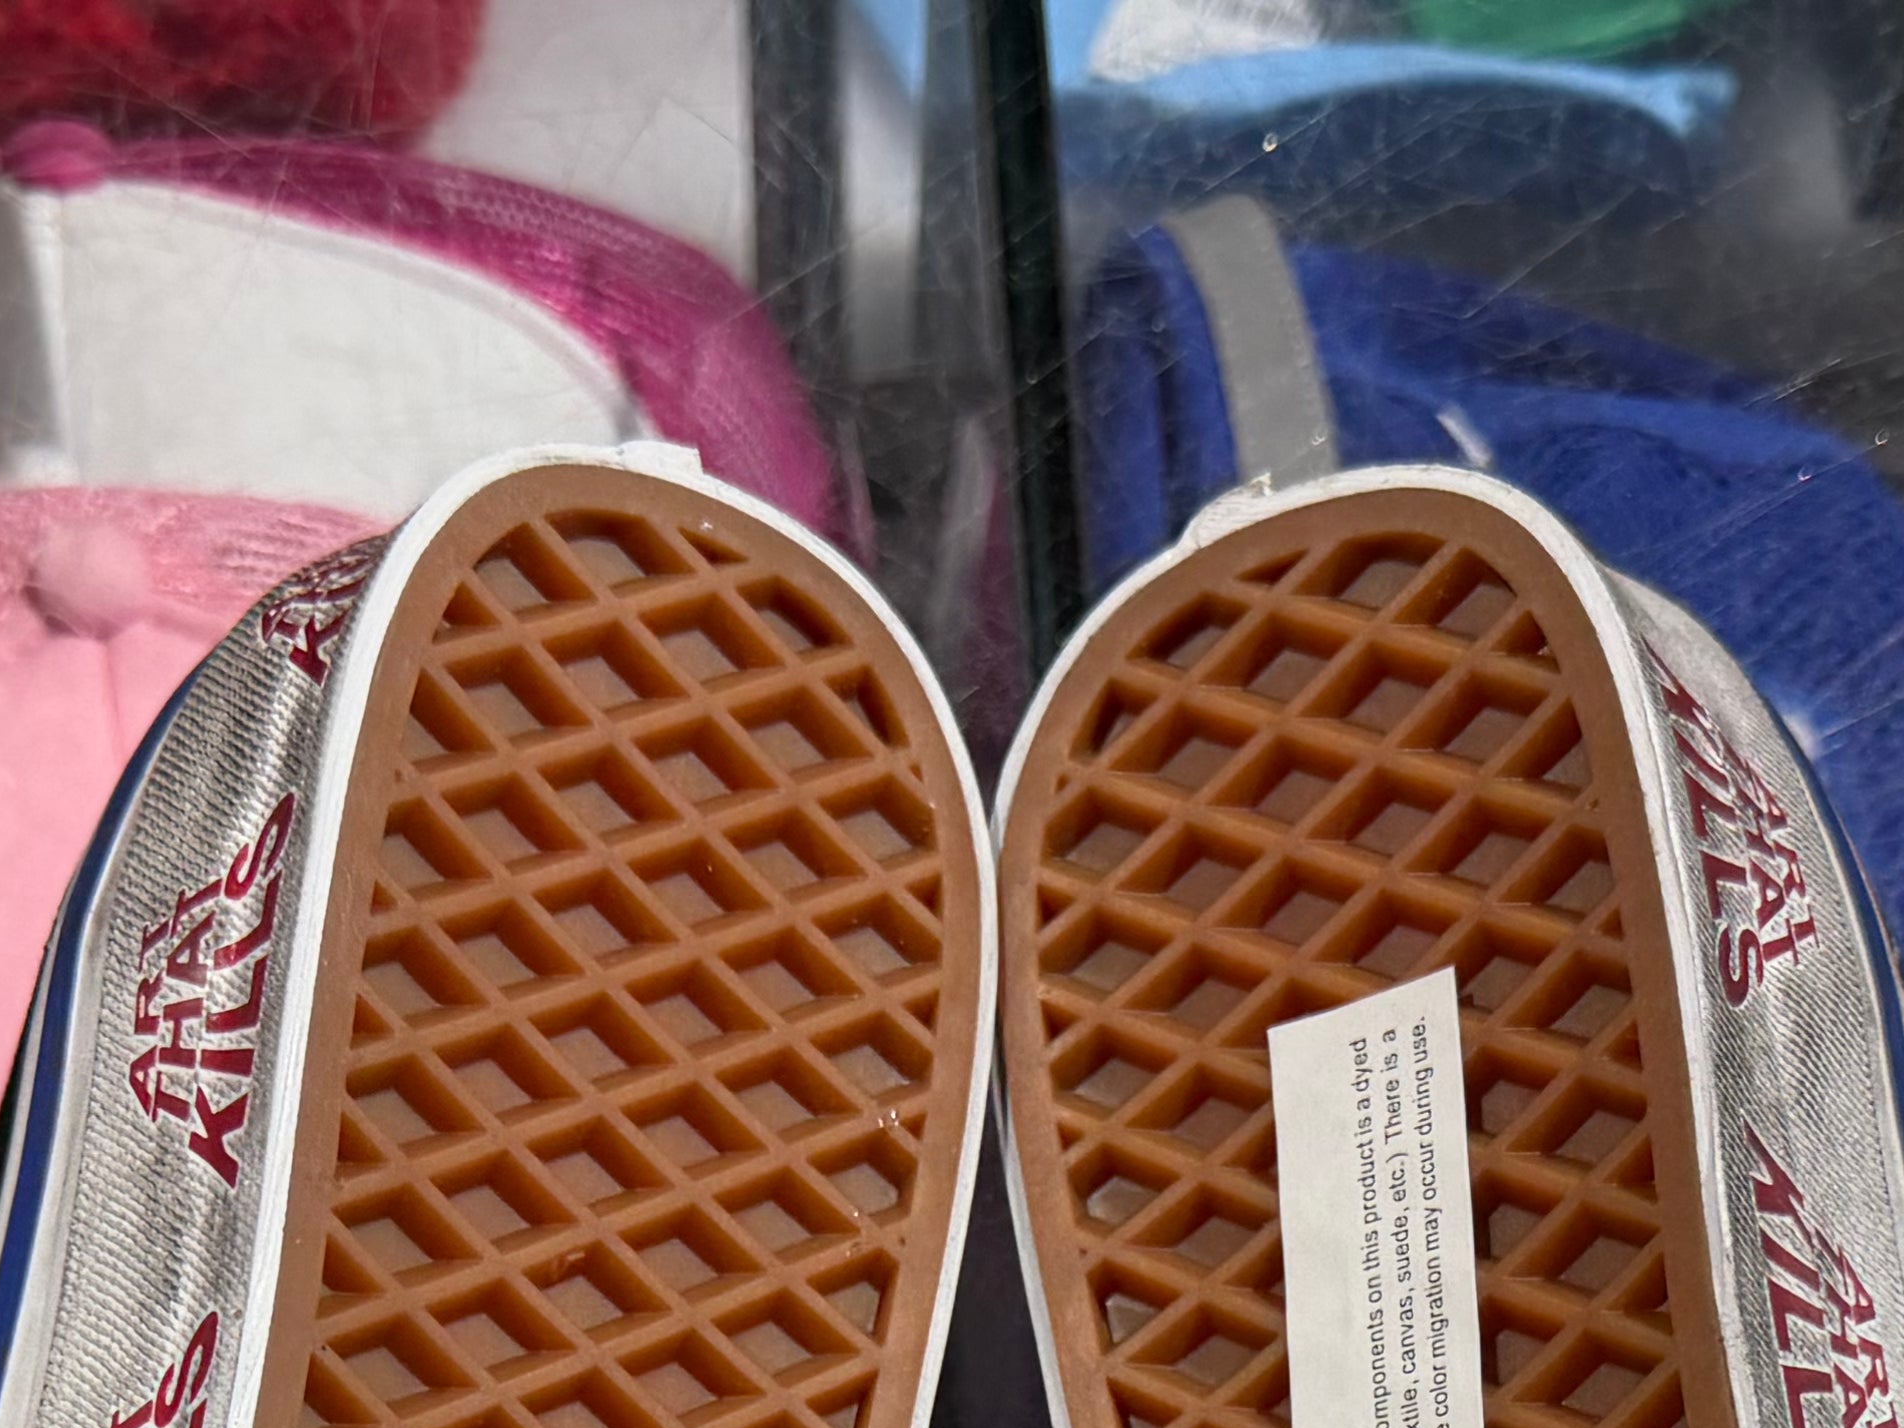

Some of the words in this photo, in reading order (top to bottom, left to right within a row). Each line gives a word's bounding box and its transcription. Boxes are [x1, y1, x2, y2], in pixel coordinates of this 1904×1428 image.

[1639, 632, 1765, 1008] KILLS
[152, 877, 226, 1122] THAT
[188, 791, 295, 1190] KILLS
[129, 918, 174, 1122] ART
[1382, 1028, 1396, 1043] a
[1411, 1015, 1428, 1065] use.
[1349, 1037, 1373, 1092] dyed
[1380, 1052, 1398, 1074] is
[1354, 1117, 1372, 1137] is
[1357, 1097, 1371, 1110] a
[1384, 1078, 1401, 1145] There
[1411, 1068, 1434, 1135] during
[1357, 1137, 1382, 1223] product
[1386, 1152, 1409, 1203] etc.)
[1417, 1139, 1437, 1201] occur
[1362, 1231, 1380, 1272] this
[1391, 1207, 1412, 1284] suede,
[1425, 1207, 1443, 1255] may
[1369, 1274, 1383, 1303] on
[1426, 1256, 1449, 1360] migration
[1399, 1287, 1417, 1374] canvas,
[1429, 1363, 1449, 1416] color
